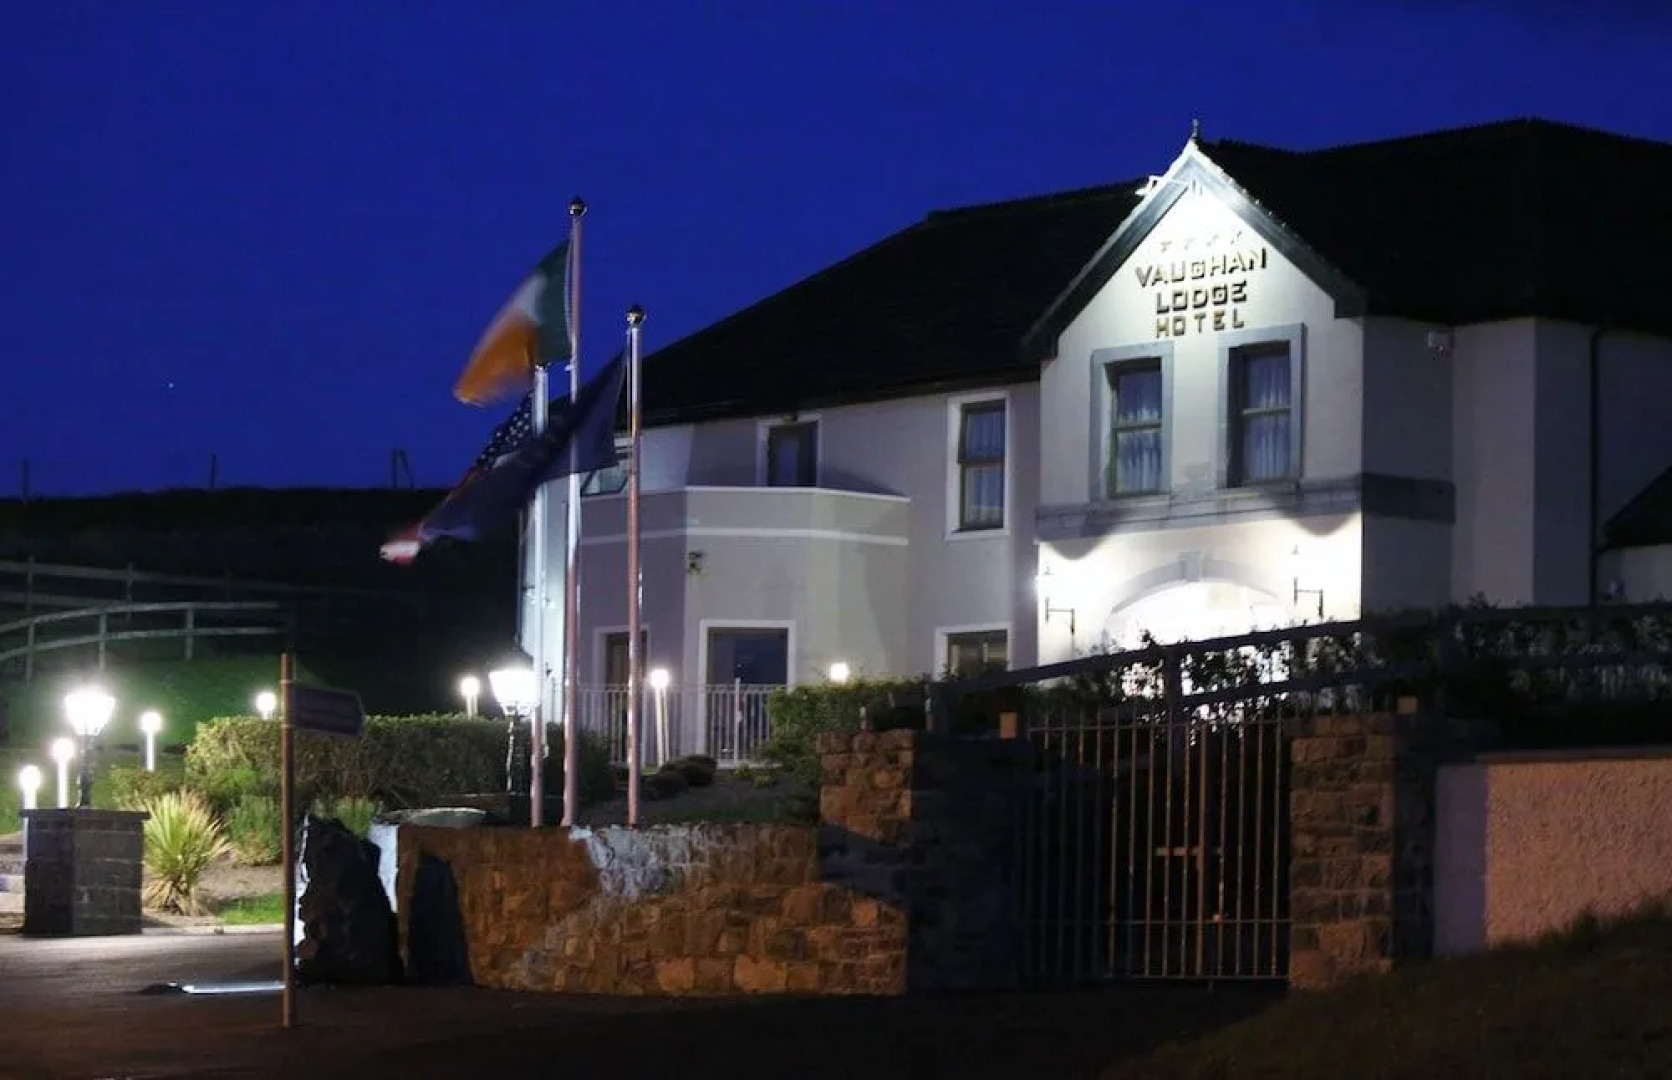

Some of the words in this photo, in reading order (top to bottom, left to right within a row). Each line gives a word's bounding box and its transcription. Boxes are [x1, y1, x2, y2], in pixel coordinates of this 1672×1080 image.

[1135, 247, 1268, 288] VAUGHAN
[1156, 279, 1248, 315] LODGE
[1156, 308, 1245, 339] HOTEL
